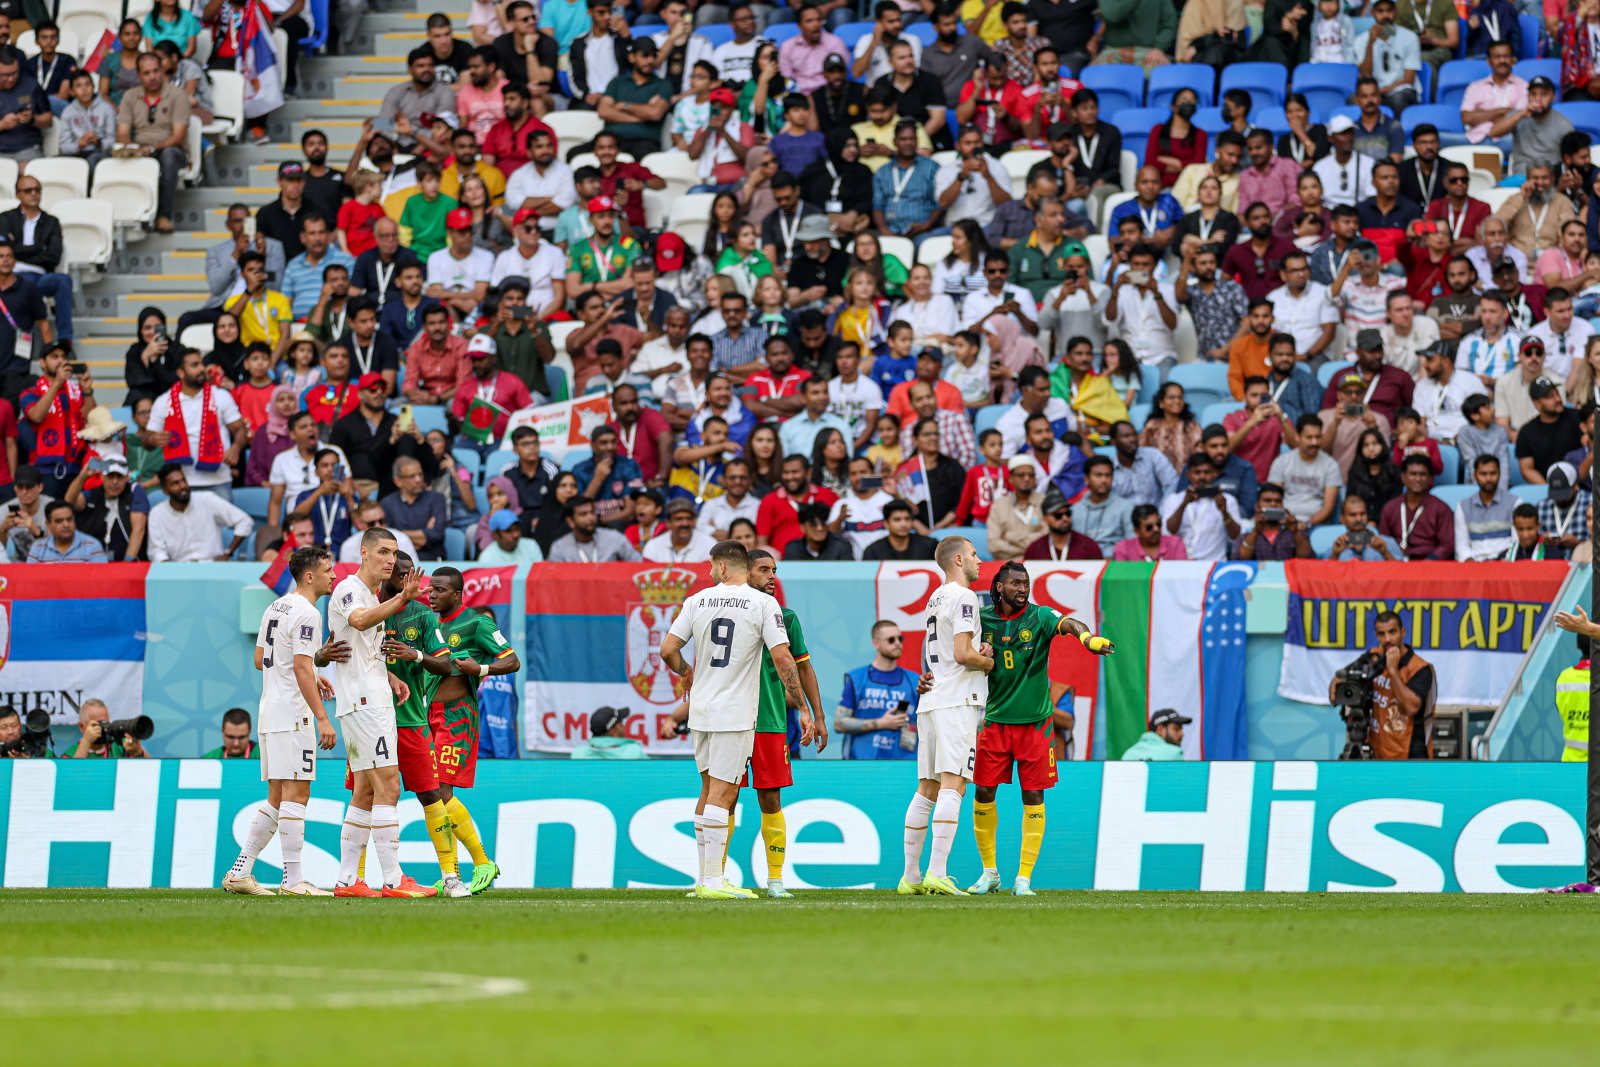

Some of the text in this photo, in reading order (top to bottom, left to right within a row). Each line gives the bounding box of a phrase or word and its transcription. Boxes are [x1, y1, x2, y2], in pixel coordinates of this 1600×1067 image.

[699, 598, 705, 609] A
[263, 619, 279, 669] 5
[710, 617, 736, 669] 9
[926, 615, 939, 664] 2
[1003, 650, 1015, 670] 8
[0, 689, 84, 716] HEN
[865, 688, 906, 700] FIFA TV
[375, 735, 389, 760] 4
[440, 745, 461, 767] 25
[1049, 747, 1055, 768] 8
[302, 749, 314, 773] 5
[3, 759, 881, 889] Hisense
